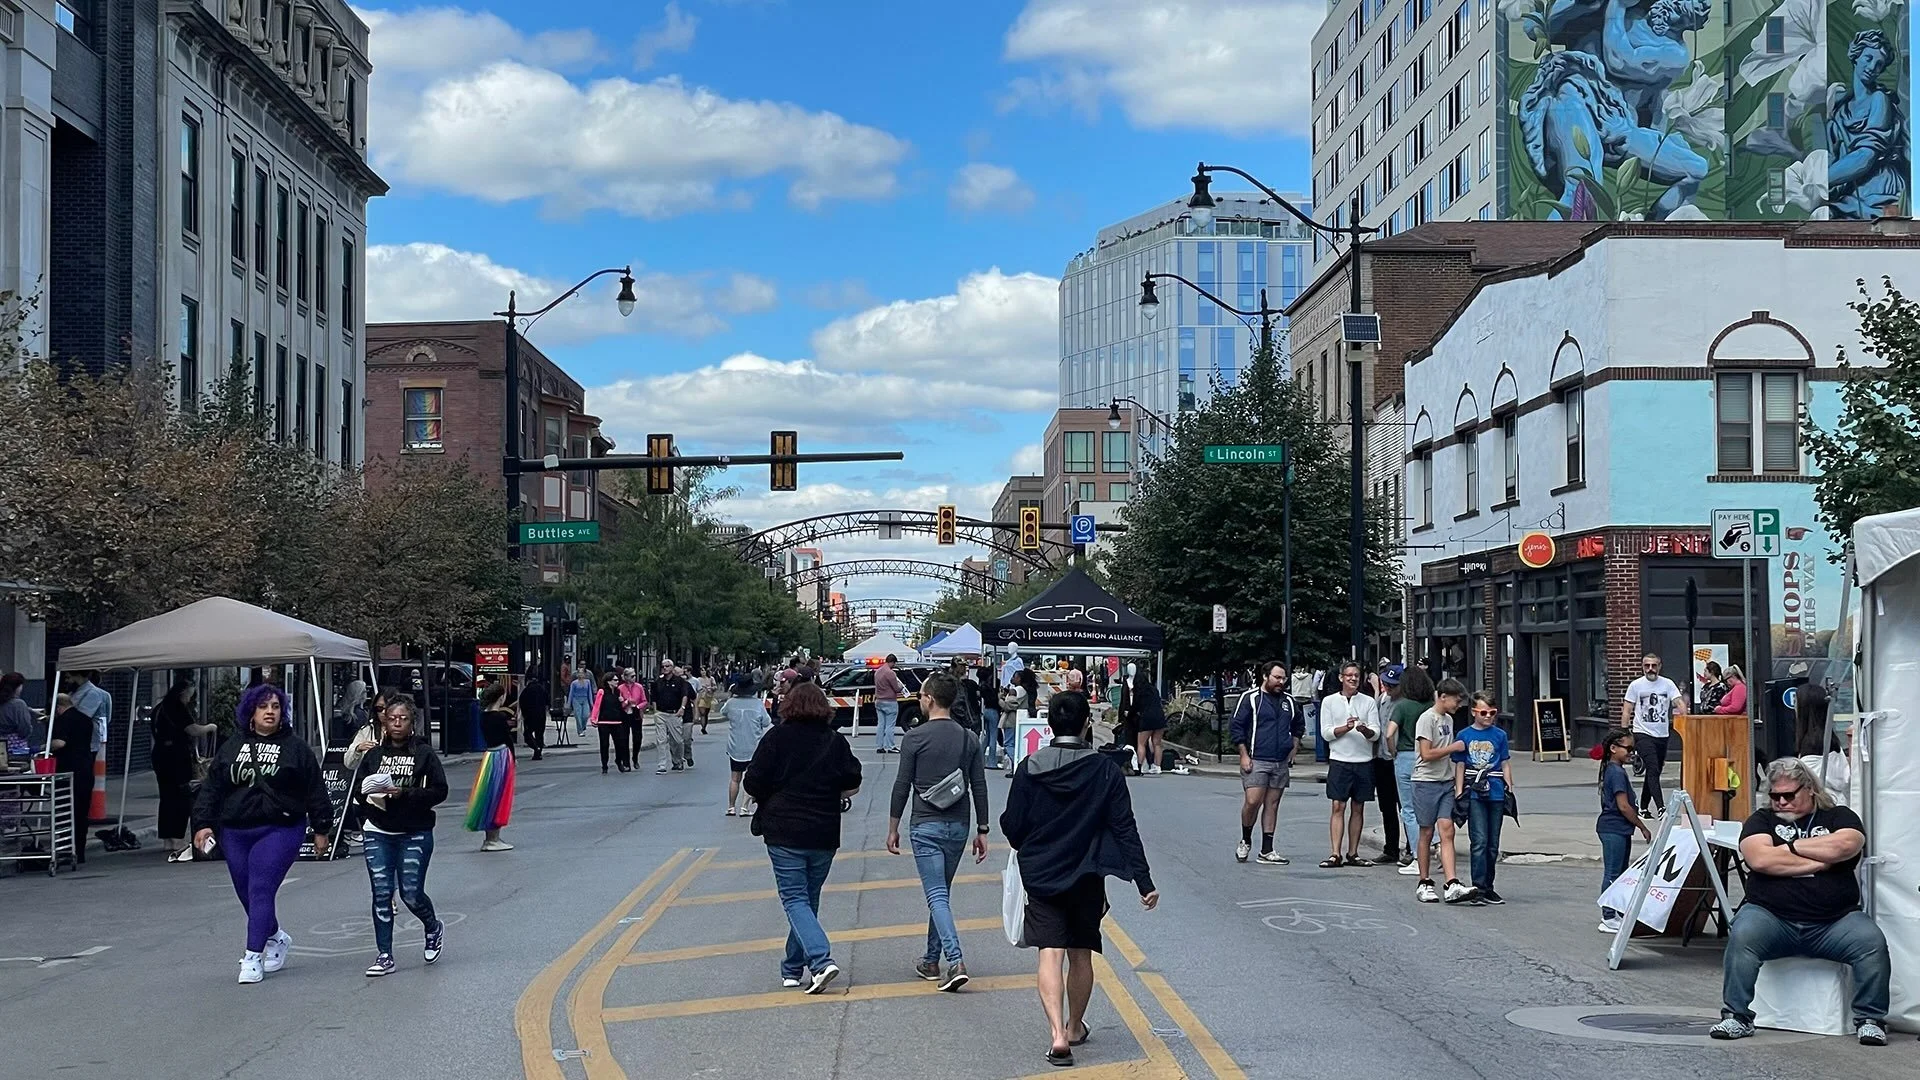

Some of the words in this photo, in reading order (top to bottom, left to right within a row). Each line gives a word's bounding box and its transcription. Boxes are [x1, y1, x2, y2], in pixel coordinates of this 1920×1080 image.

[1217, 448, 1265, 460] Lincoln
[1733, 513, 1751, 521] HERE
[1758, 513, 1775, 533] P
[528, 527, 575, 539] Buttles
[1803, 552, 1815, 594] WAY
[1804, 597, 1816, 649] THIS
[1032, 630, 1073, 639] COLUMBUS
[1074, 631, 1107, 640] FASHION
[1108, 633, 1144, 643] ALLIANCE
